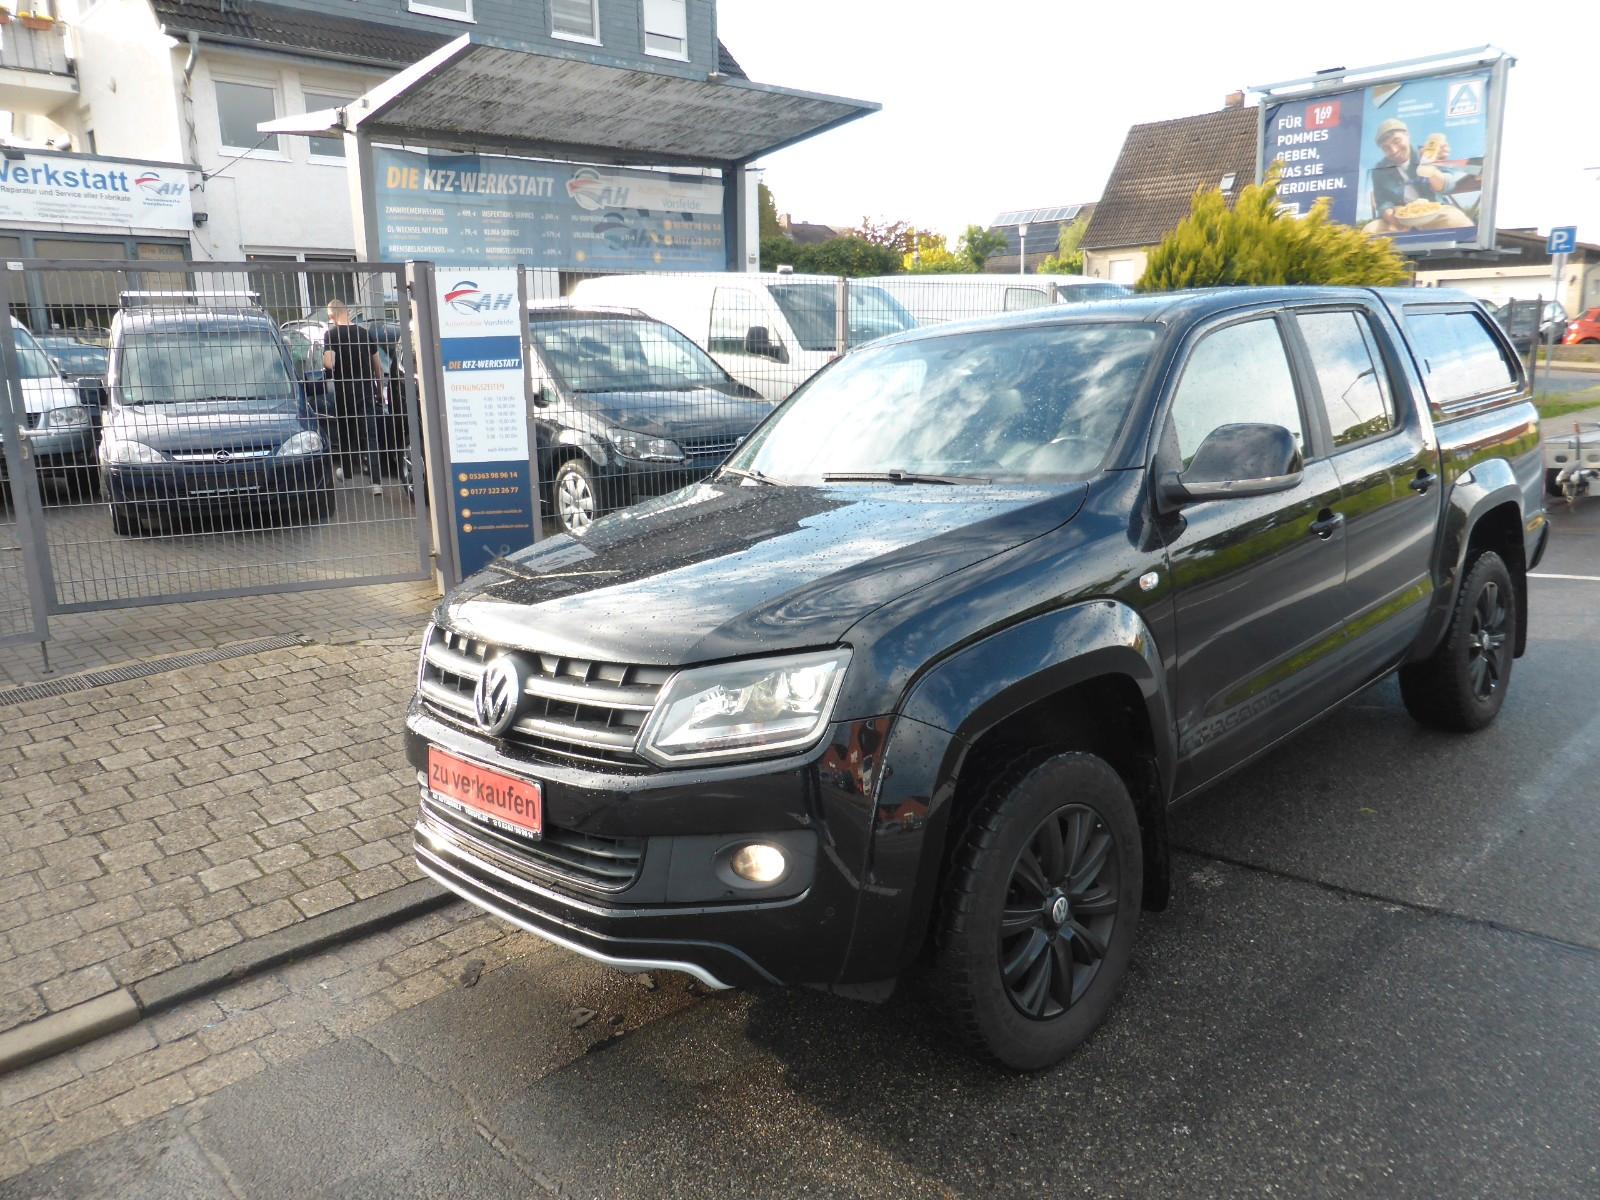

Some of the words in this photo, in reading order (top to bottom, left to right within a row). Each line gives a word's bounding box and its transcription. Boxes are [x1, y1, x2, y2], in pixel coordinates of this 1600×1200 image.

[1278, 115, 1302, 130] FÜR
[1277, 129, 1329, 147] POMMES
[1276, 147, 1320, 162] GEBEN,
[1303, 163, 1324, 176] SIE
[159, 182, 186, 196] AH
[387, 167, 418, 191] DIE
[424, 169, 554, 197] KFZ-WERKSTATT
[1275, 177, 1347, 195] VERDIENEN.
[1, 185, 37, 194] Reparatur
[55, 190, 82, 198] Service
[601, 185, 631, 206] AH
[1552, 231, 1568, 250] P
[478, 293, 513, 311] AH
[449, 360, 462, 369] DIE
[462, 359, 520, 369] KFZ-WERKSTATT
[433, 763, 449, 786] zu
[452, 769, 537, 819] verkaufen
